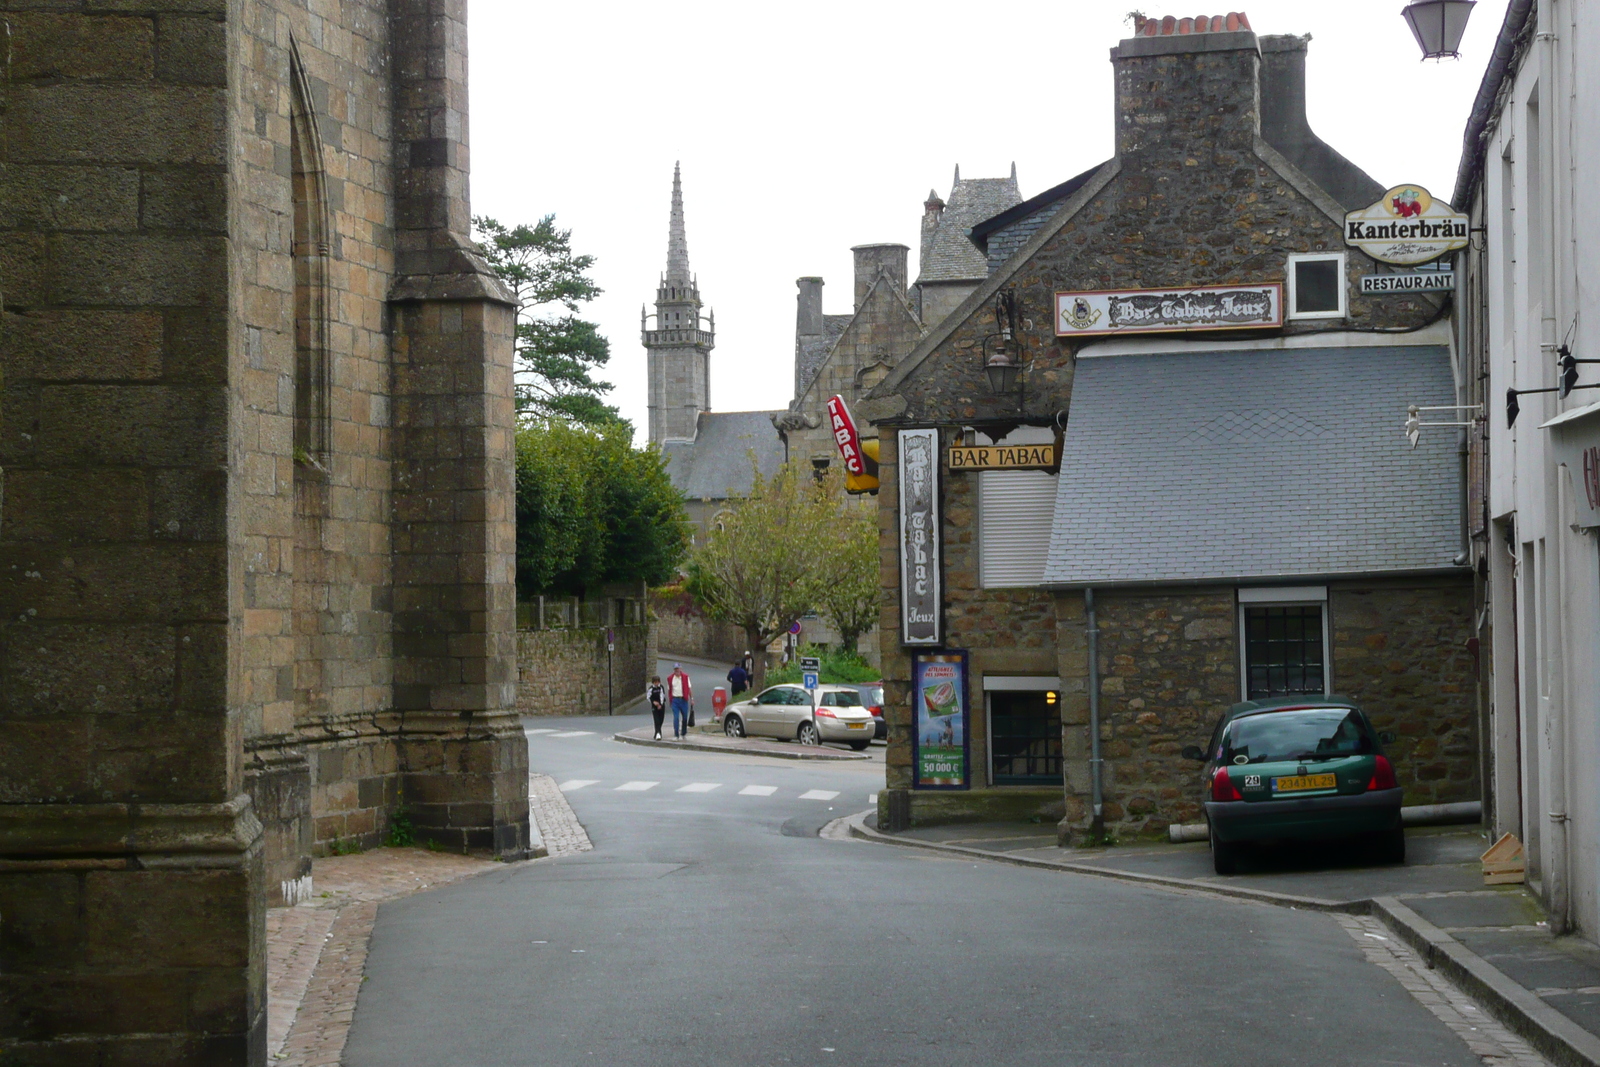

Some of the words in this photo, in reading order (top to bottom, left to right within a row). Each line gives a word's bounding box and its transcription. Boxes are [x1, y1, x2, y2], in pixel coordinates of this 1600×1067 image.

[1348, 220, 1466, 239] Kanterbräu
[1364, 276, 1452, 290] RESTAURANT
[1220, 296, 1267, 317] Jeux
[827, 399, 860, 473] TABAC
[952, 449, 990, 467] BAR
[996, 447, 1052, 466] TABAC
[906, 446, 928, 498] Bar
[911, 511, 928, 597] Tabac
[908, 606, 934, 624] Jeux
[807, 676, 814, 687] P
[924, 762, 935, 773] 50
[935, 762, 952, 773] 000
[1246, 776, 1259, 784] 29
